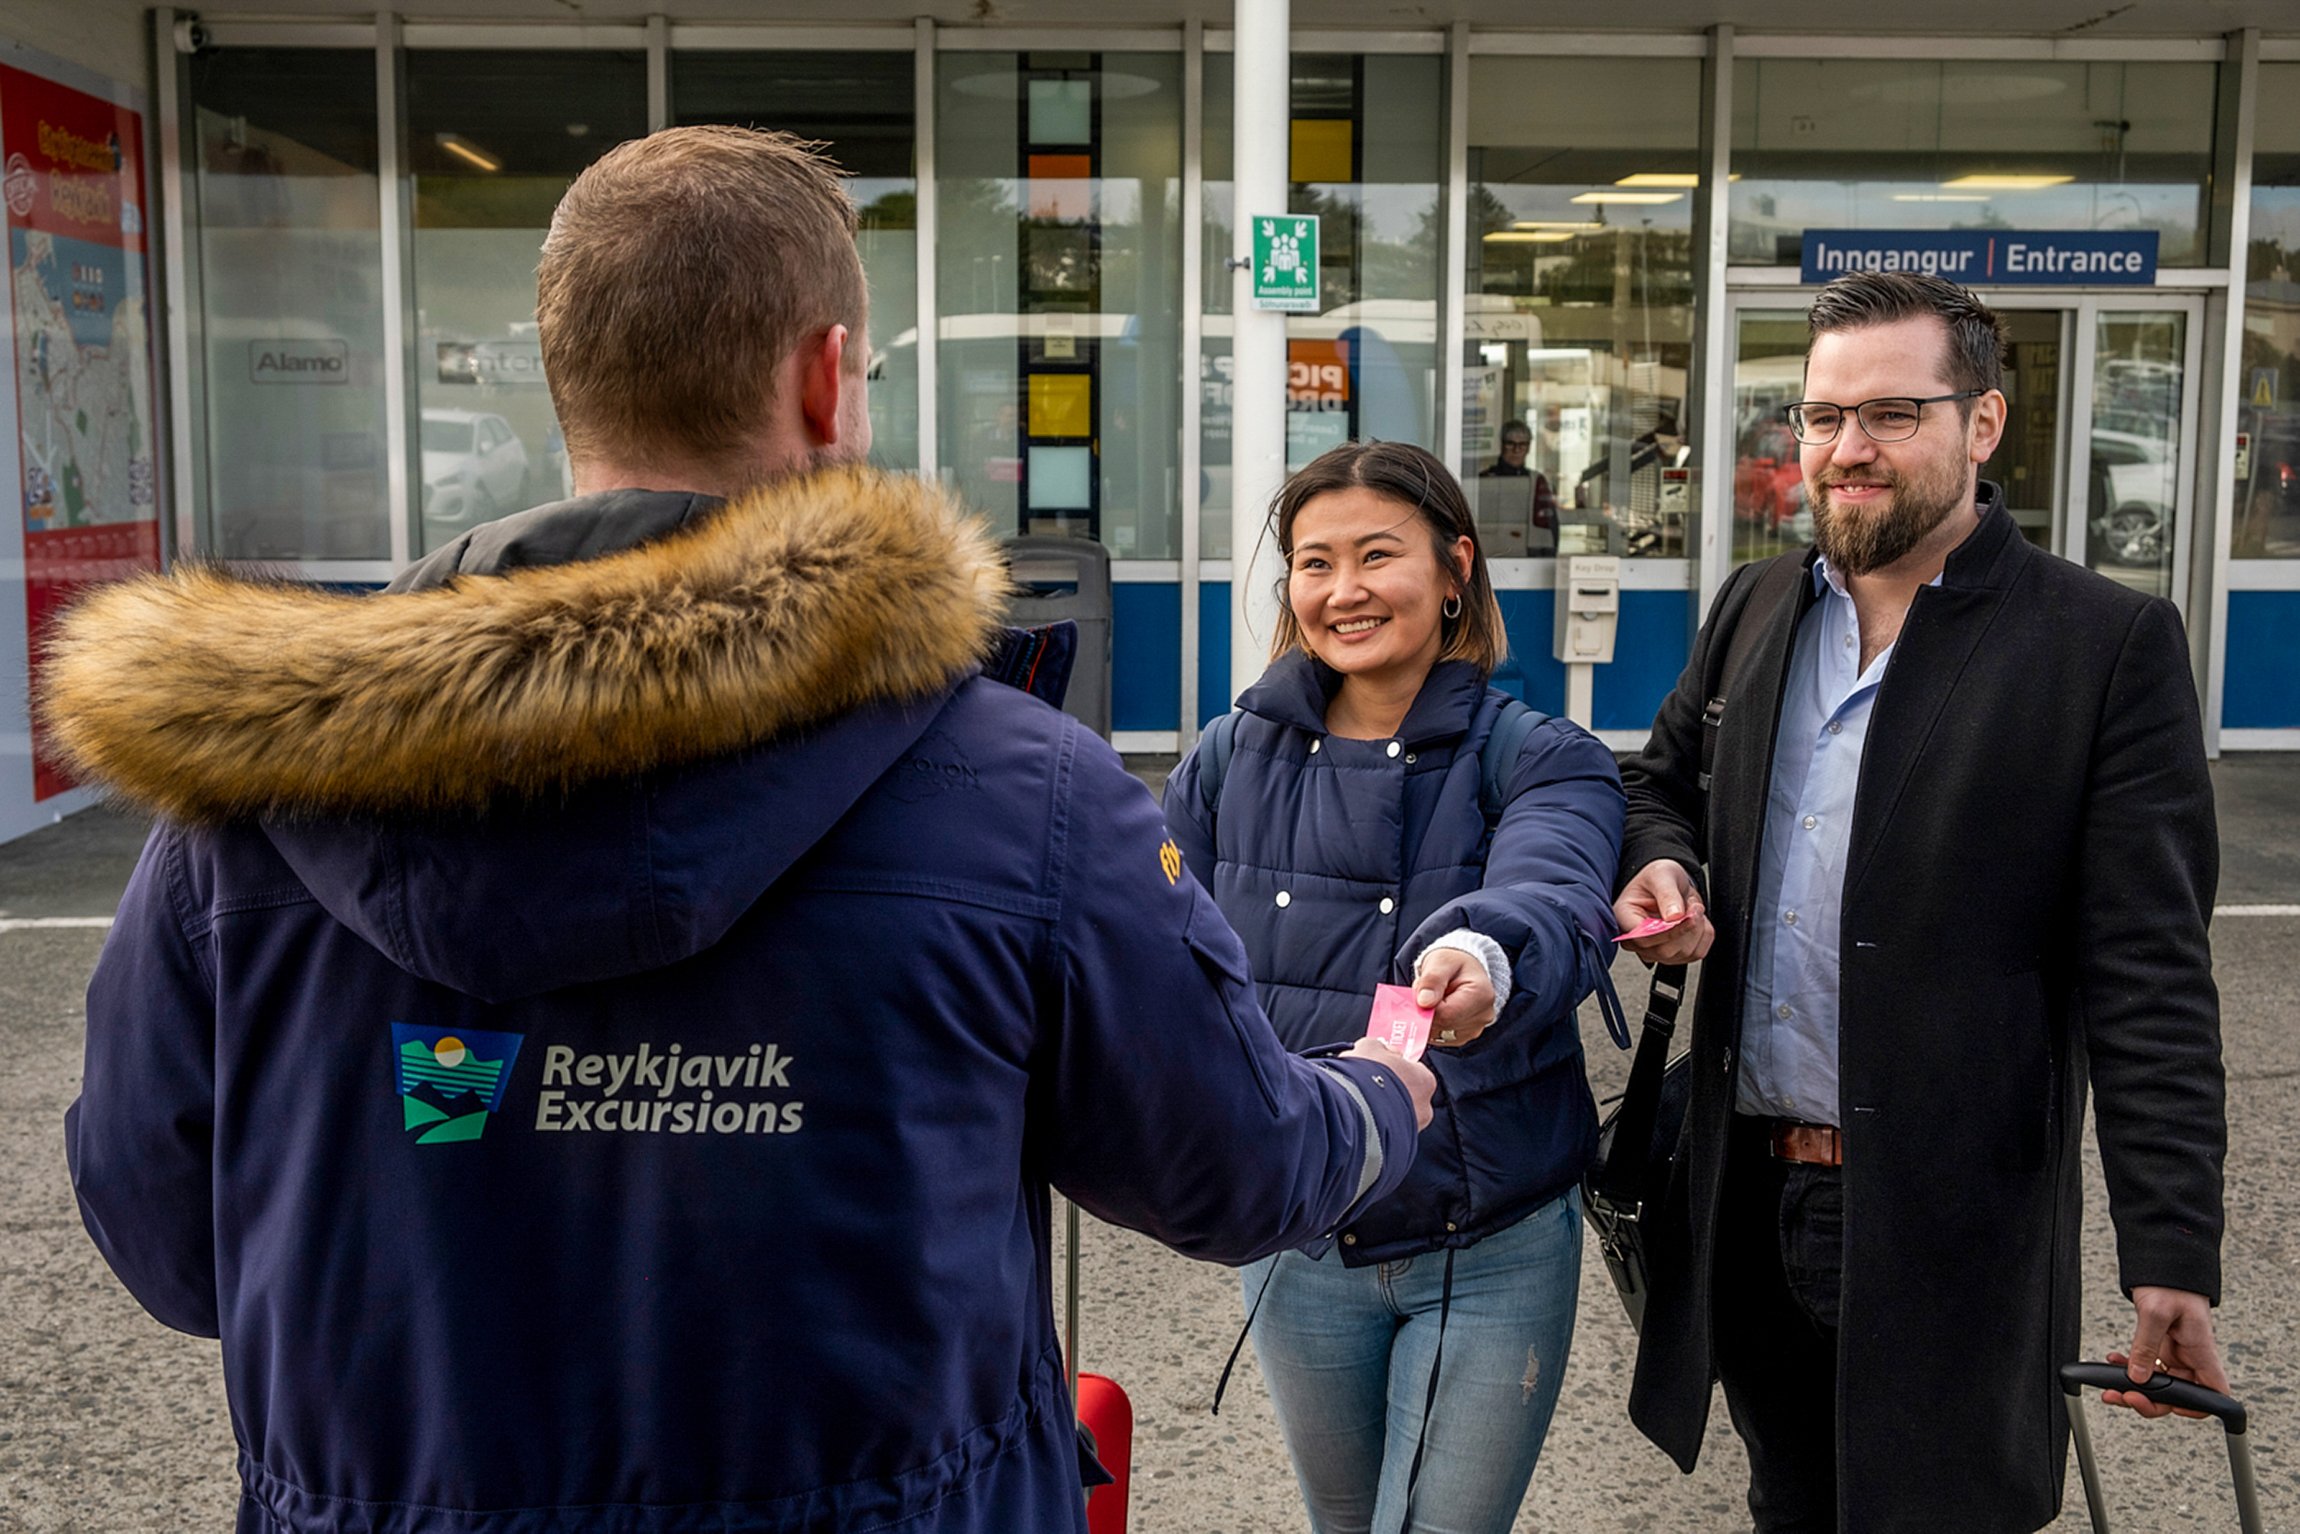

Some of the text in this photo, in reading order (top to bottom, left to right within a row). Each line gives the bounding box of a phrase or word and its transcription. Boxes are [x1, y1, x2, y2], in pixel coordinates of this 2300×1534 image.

[1817, 243, 2143, 275] Inngangur Entrance
[1258, 285, 1313, 297] Assembly point
[256, 352, 343, 373] Alamo
[1575, 564, 1616, 574] Key Drop
[542, 1043, 794, 1098] Reykjavik
[534, 1091, 804, 1134] Excursions
